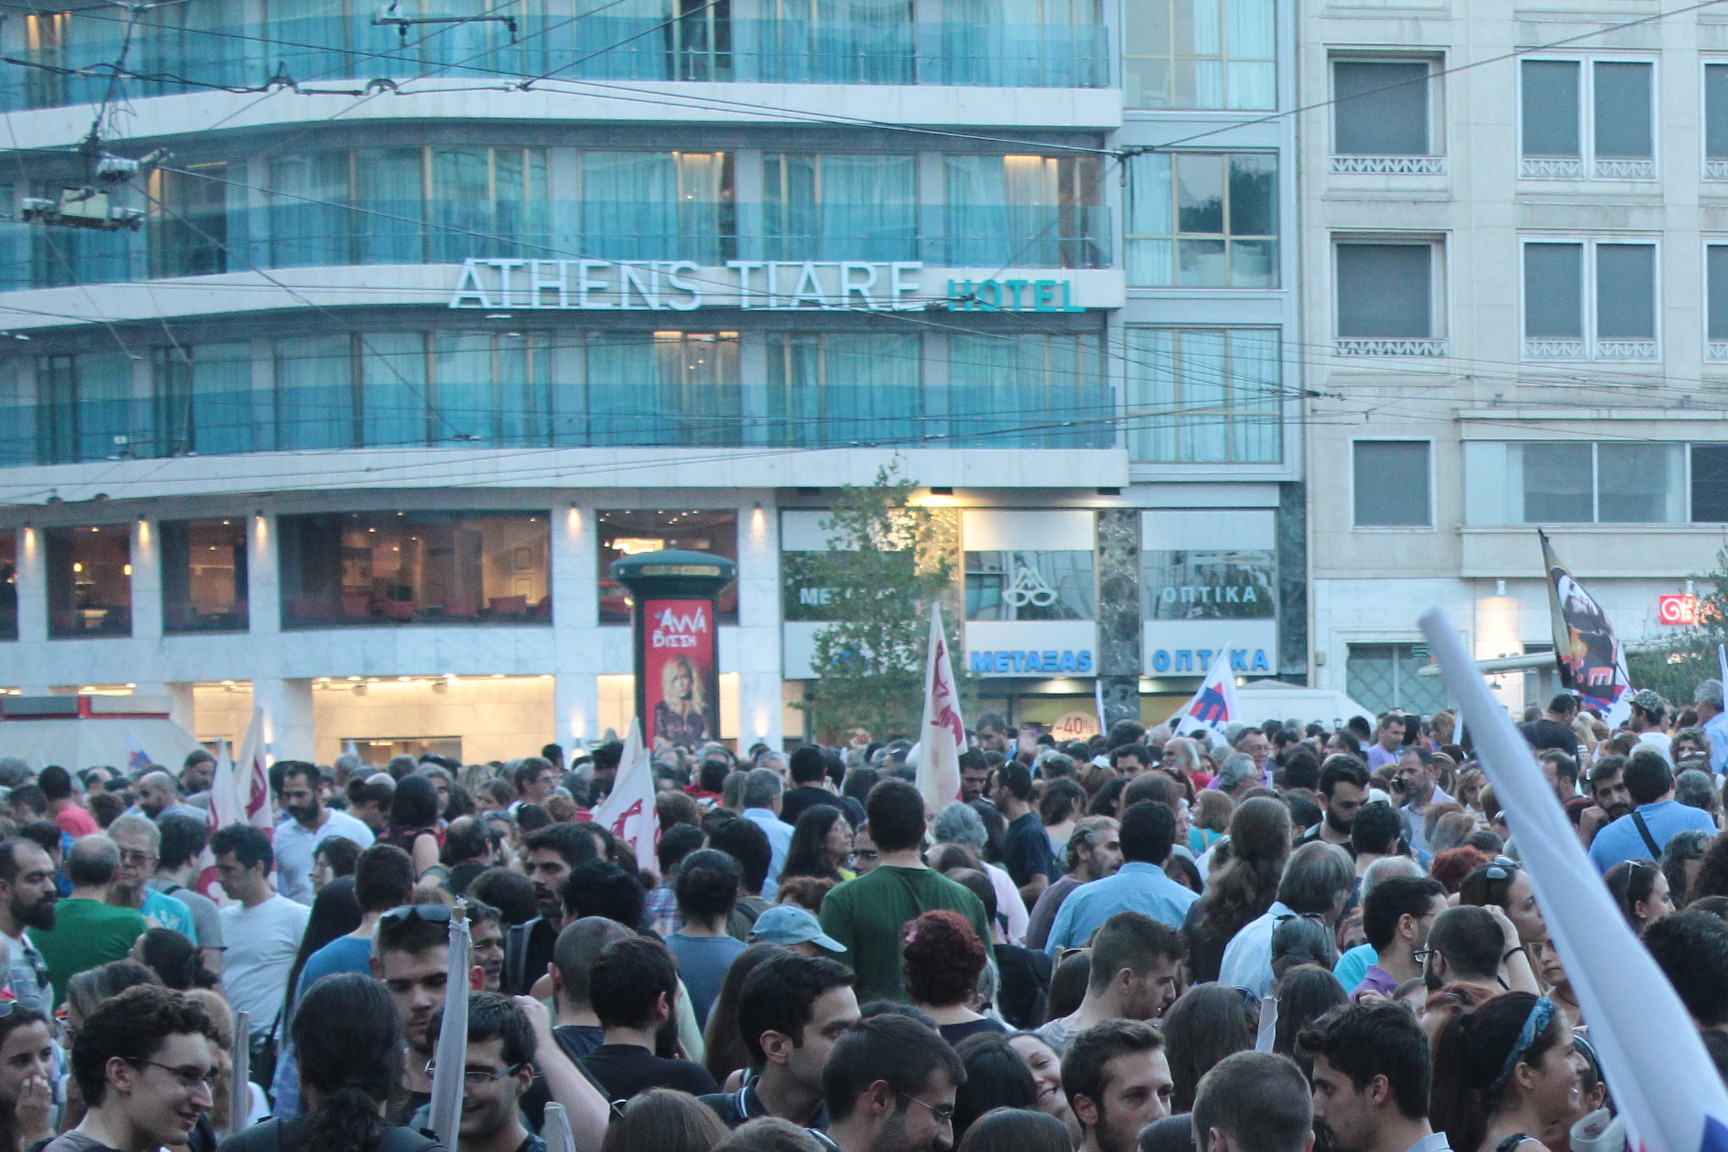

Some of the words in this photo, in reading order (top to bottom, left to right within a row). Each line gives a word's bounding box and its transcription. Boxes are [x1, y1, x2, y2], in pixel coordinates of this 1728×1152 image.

[448, 258, 702, 312] ATHENS
[726, 259, 925, 313] TIARE
[946, 278, 1086, 313] HOTEL
[1162, 586, 1257, 603] ΟΠΤΙΚΑ
[1153, 650, 1269, 672] ΟΠΤΚΑ
[1055, 716, 1095, 734] -40%
